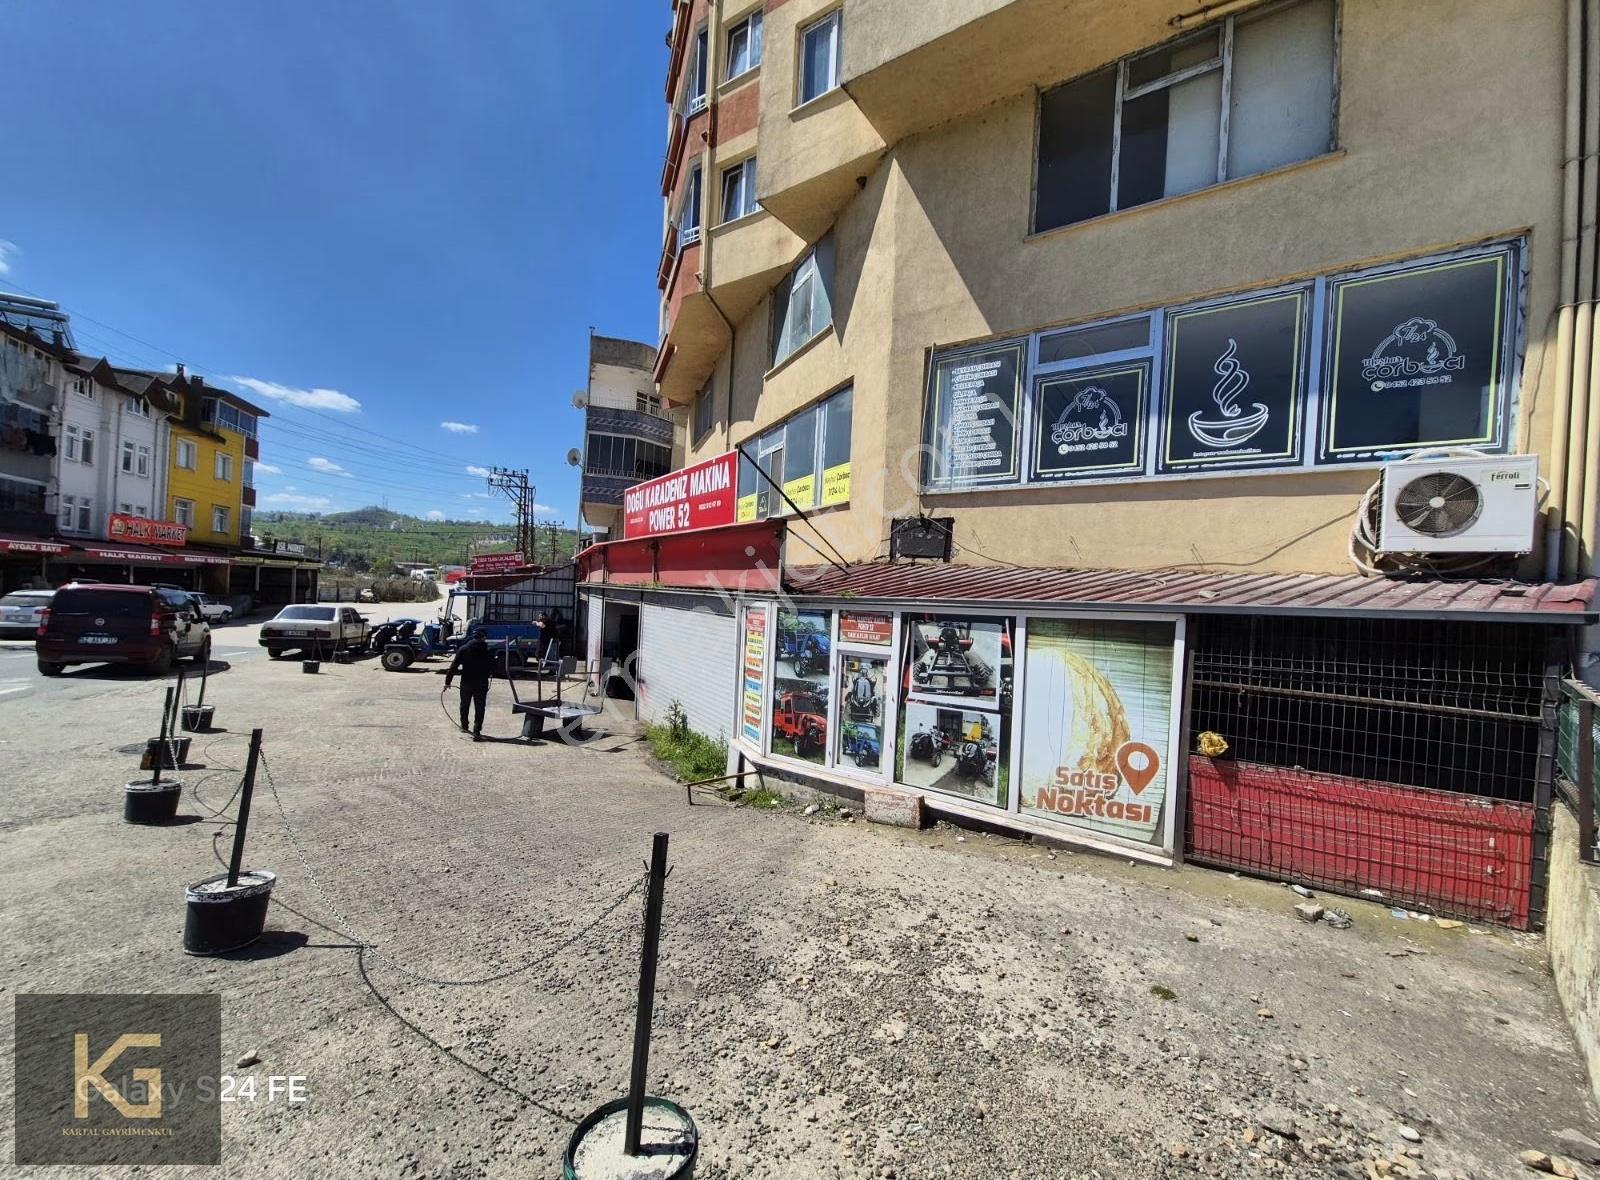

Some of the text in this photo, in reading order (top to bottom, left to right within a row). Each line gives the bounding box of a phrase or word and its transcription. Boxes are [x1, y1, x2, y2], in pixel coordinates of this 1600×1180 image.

[626, 459, 730, 513] DOĞU KARADENİZ MAKİNA
[1490, 470, 1520, 482] Ferroli
[126, 519, 187, 541] HALK MARKET
[649, 506, 675, 532] POWER
[678, 502, 690, 528] 52
[8, 542, 37, 551] AYGAZ
[1055, 765, 1119, 800] Satış
[1035, 786, 1152, 823] Noktası
